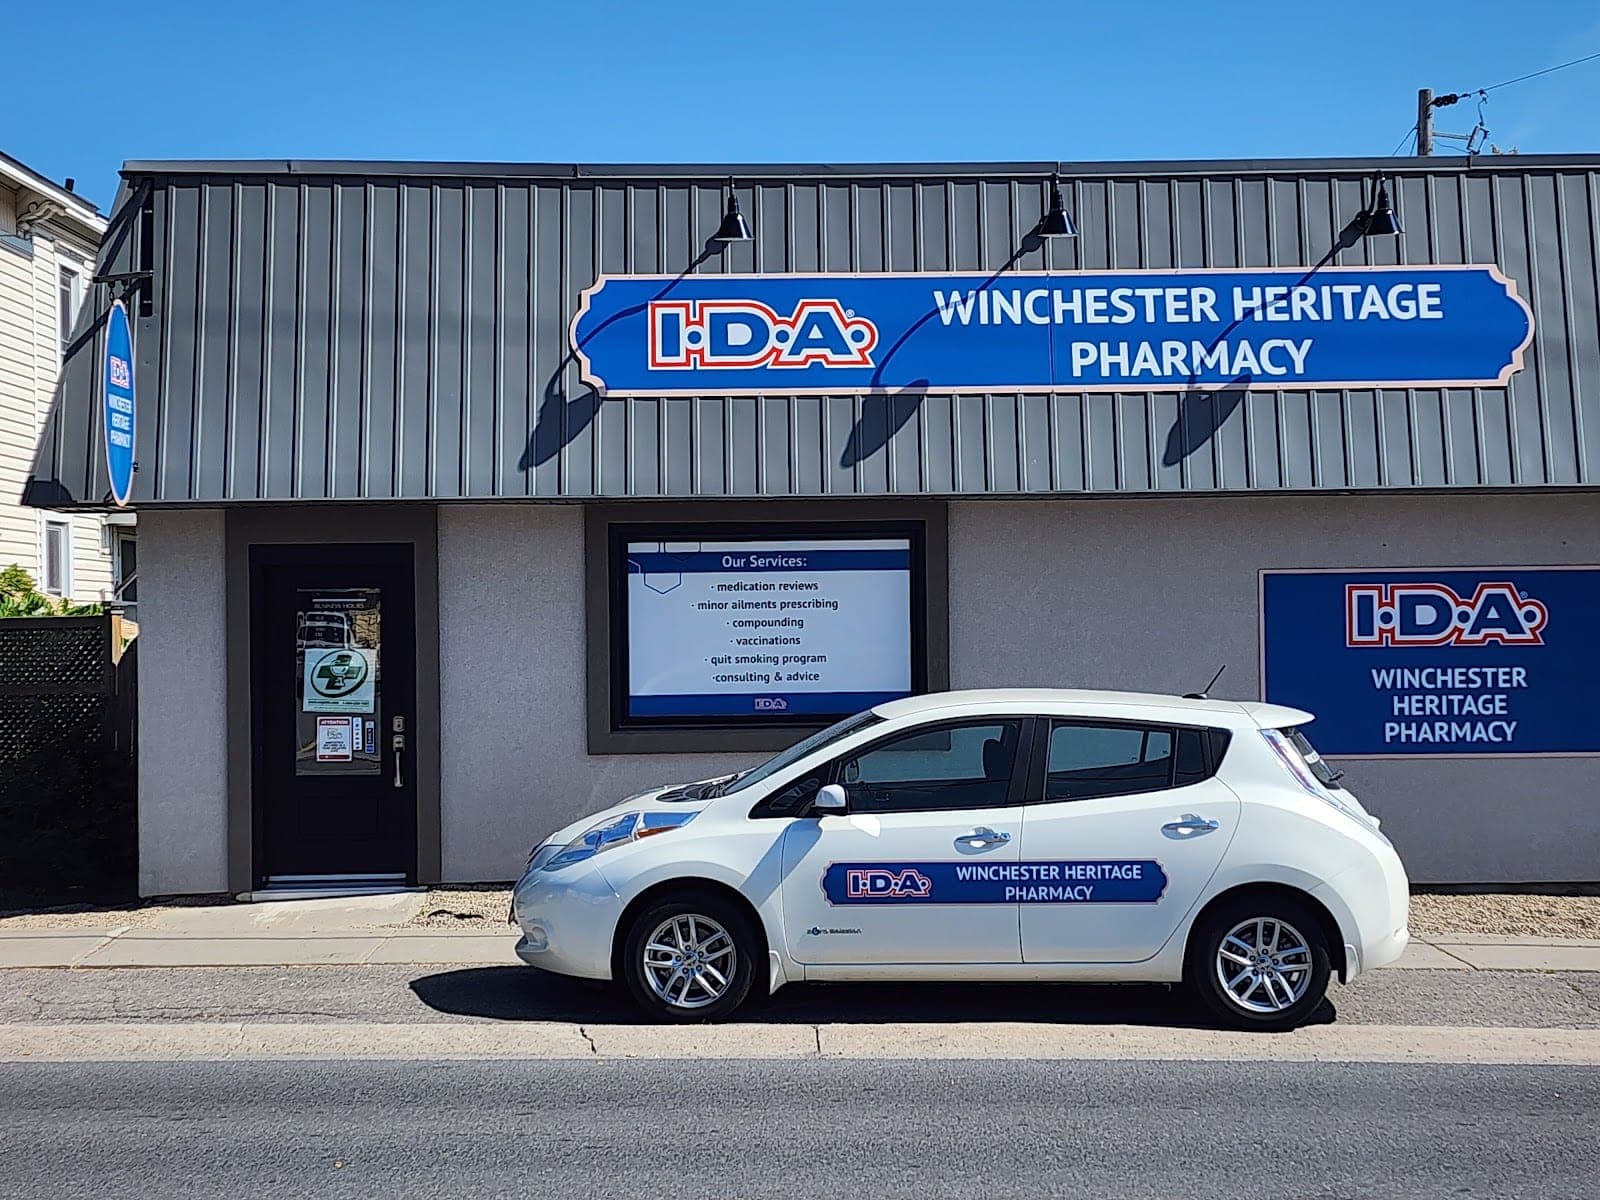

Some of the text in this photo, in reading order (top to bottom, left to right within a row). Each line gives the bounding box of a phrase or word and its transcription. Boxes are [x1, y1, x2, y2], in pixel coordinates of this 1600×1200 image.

[933, 284, 1443, 325] WINCHESTER HERITAGE
[1071, 339, 1313, 377] PHARMACY
[722, 554, 808, 568] Our Services:
[717, 581, 818, 591] medication reviews
[697, 599, 839, 611] minor ailments prescribing
[732, 617, 804, 629] compounding
[736, 635, 801, 646] vaccinations
[711, 654, 827, 666] quit smoking program
[774, 672, 783, 682] &
[786, 671, 820, 682] advice
[1371, 667, 1528, 689] WINCHESTER
[1393, 694, 1508, 716] HERITAGE
[1384, 721, 1518, 743] PHARMACY
[956, 864, 1142, 881] WINCHESTER HERITAGE
[1005, 885, 1094, 901] PHARMACY
